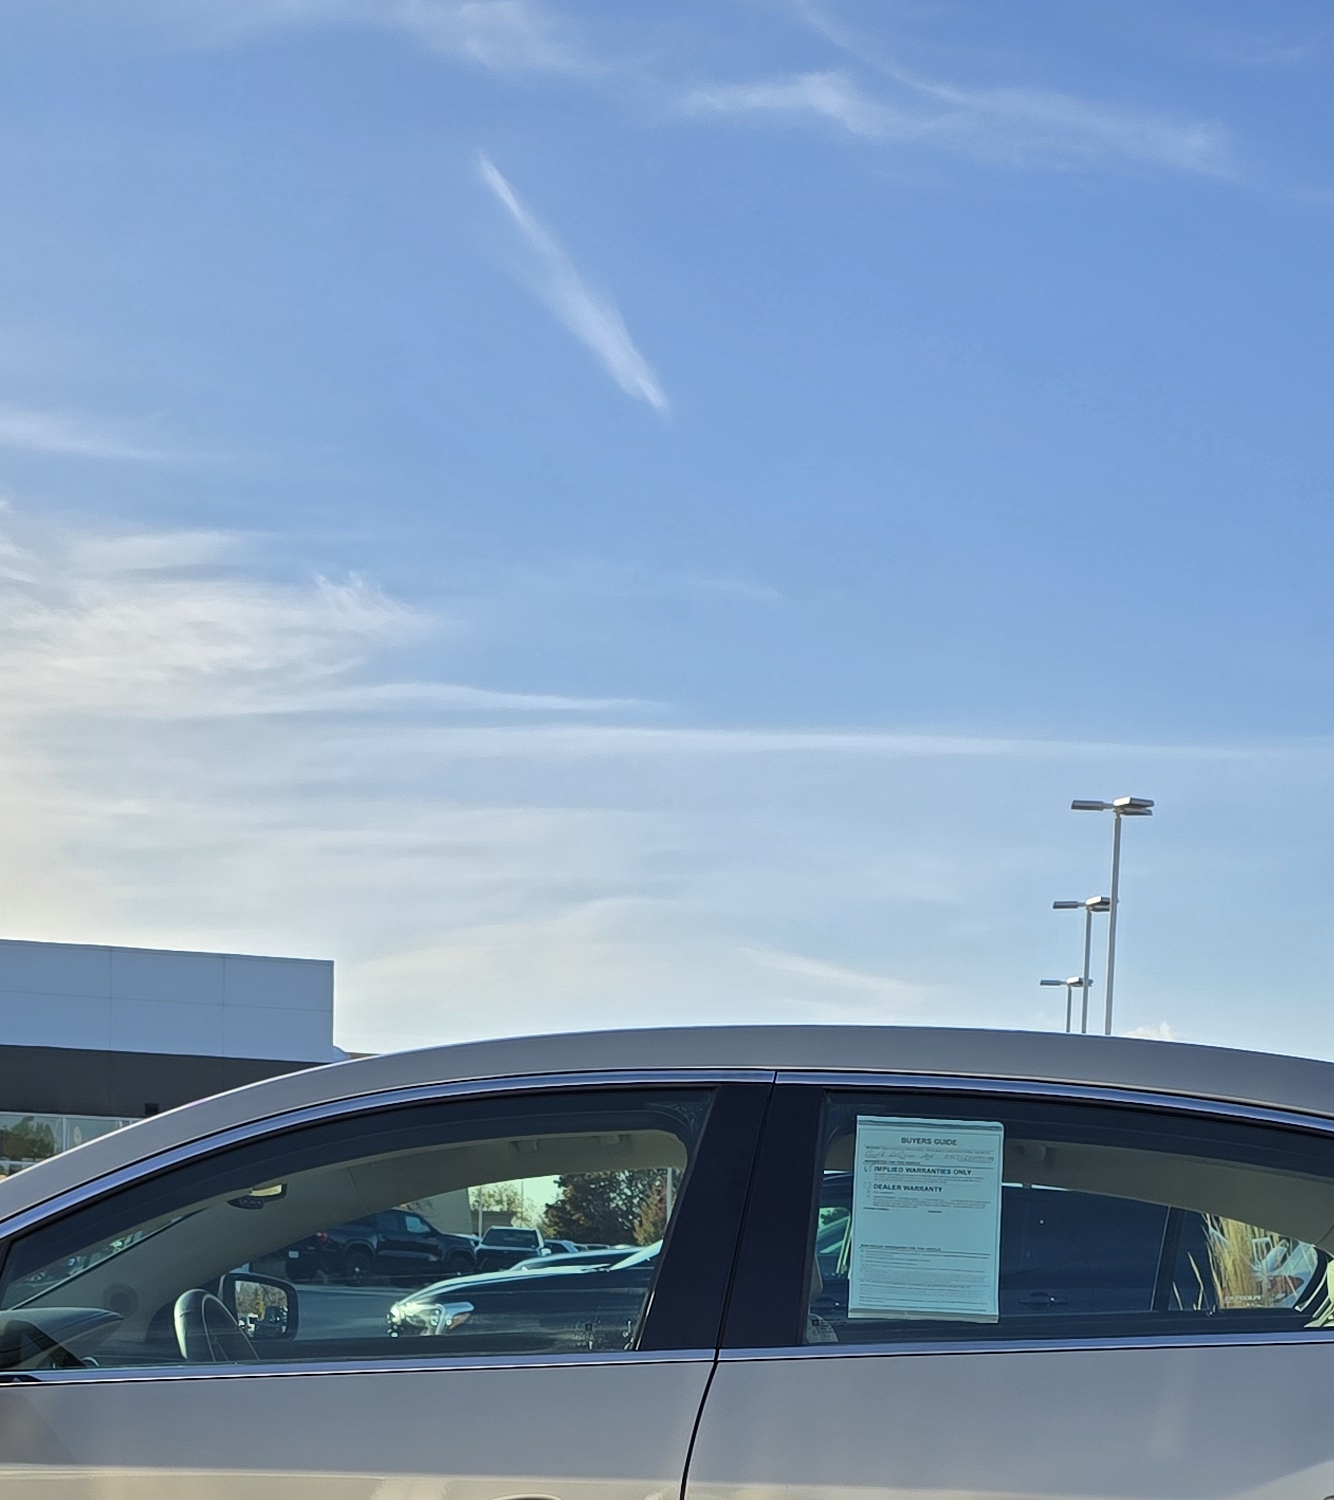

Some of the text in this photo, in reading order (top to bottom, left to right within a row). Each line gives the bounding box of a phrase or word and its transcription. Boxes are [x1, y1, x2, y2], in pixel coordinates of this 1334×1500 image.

[901, 1137, 957, 1146] BUYERS GUIDE
[905, 1167, 951, 1175] WARRANTIES
[953, 1168, 972, 1176] ONLY
[873, 1183, 902, 1191] DEALER
